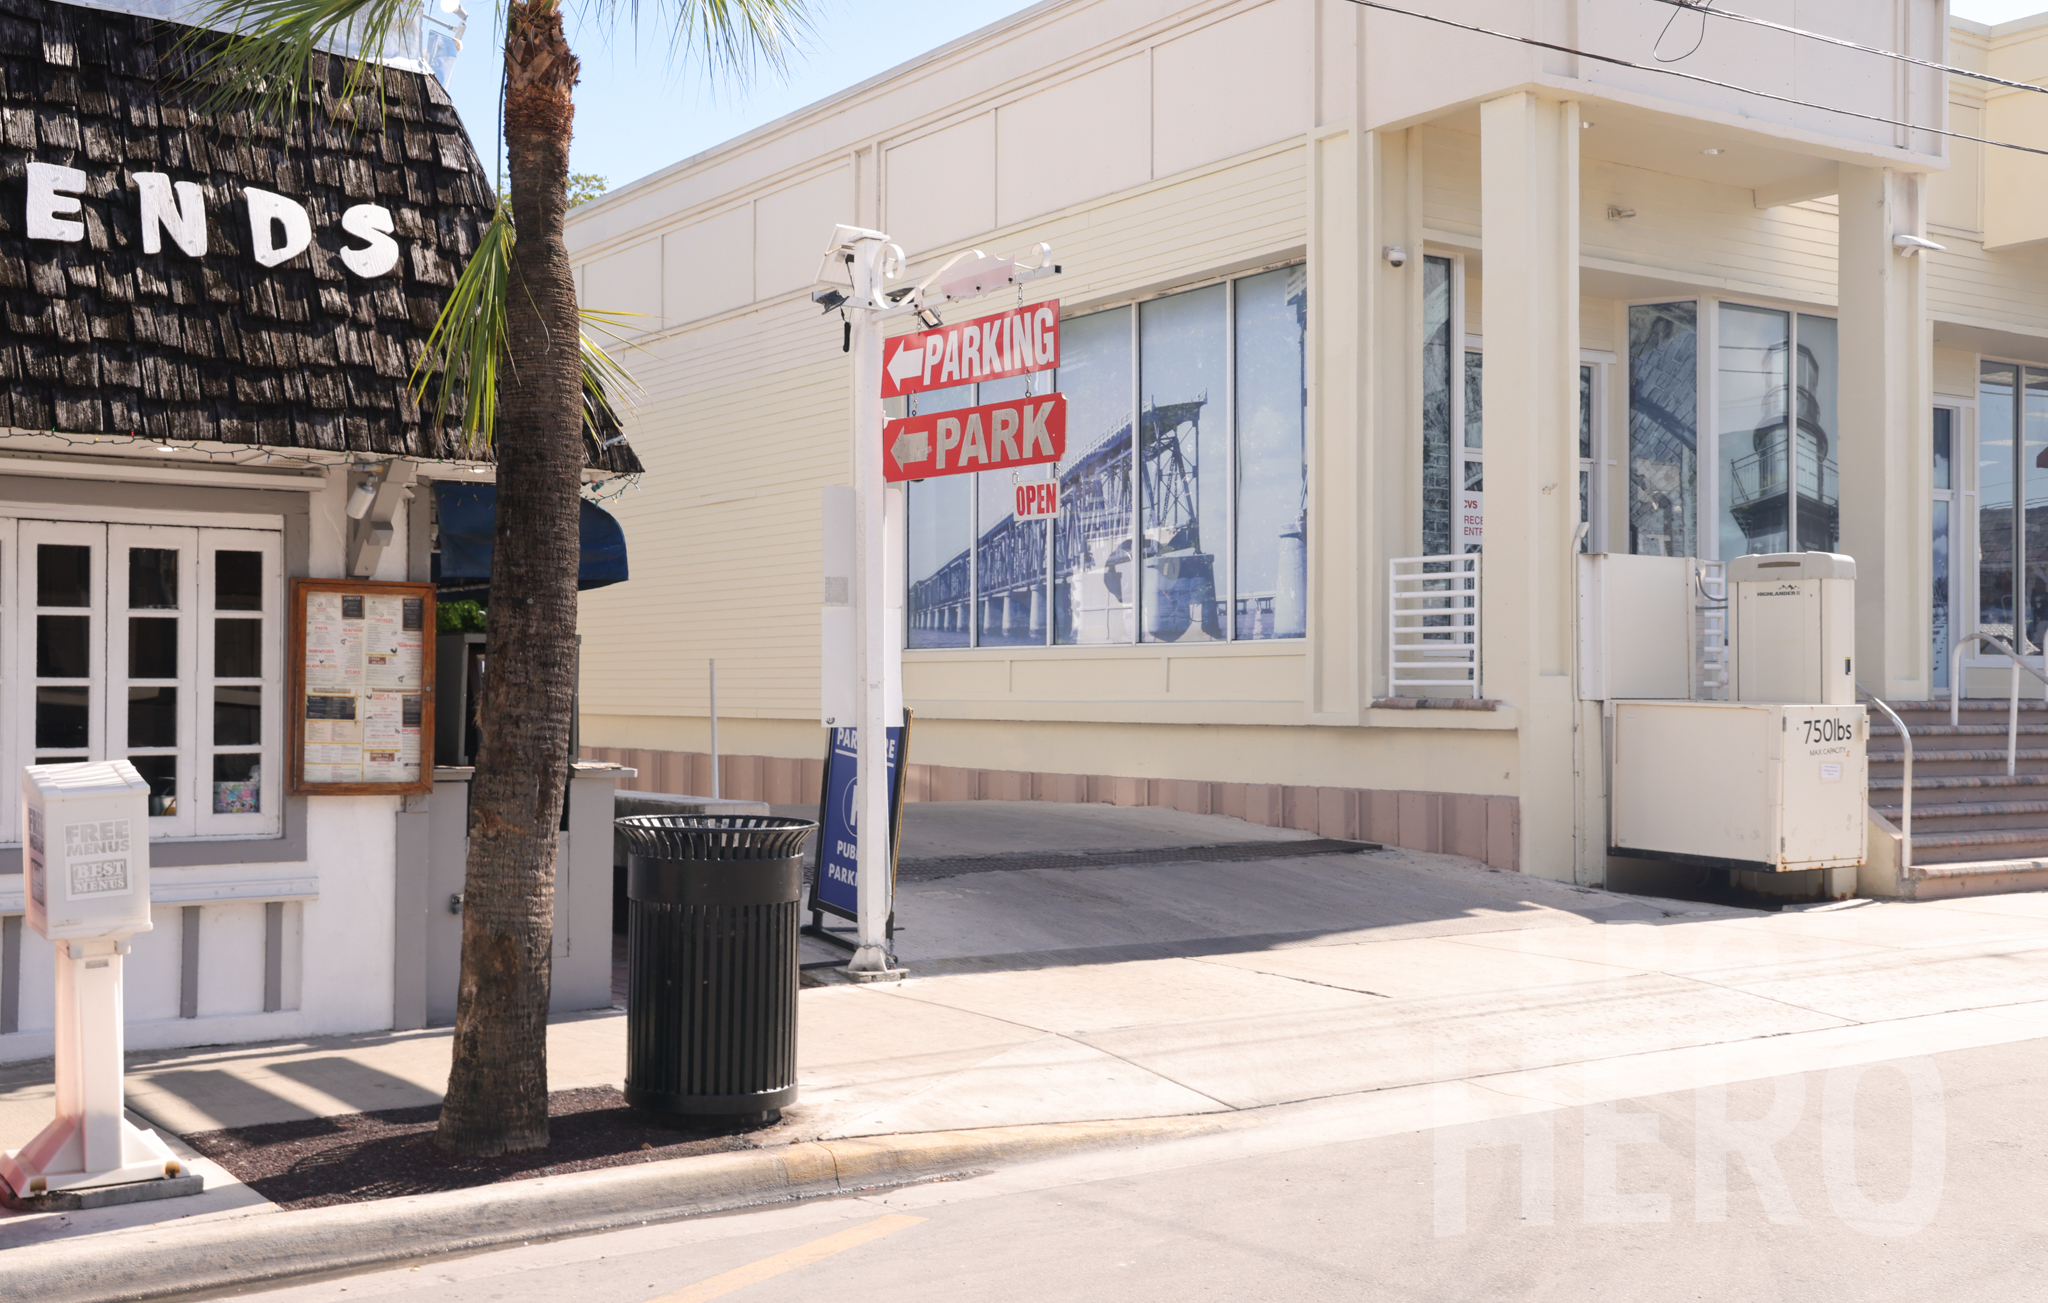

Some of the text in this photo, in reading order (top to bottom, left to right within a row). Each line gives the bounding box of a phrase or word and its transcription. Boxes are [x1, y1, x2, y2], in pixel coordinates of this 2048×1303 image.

[26, 162, 399, 278] ENDS
[923, 307, 1054, 386] PARKING
[936, 400, 1055, 470] PARK
[1016, 483, 1057, 516] OPEN
[837, 727, 858, 749] PAR
[1803, 718, 1852, 744] 750lbs
[1823, 746, 1846, 755] CAPACITY
[65, 820, 129, 844] FREE
[66, 840, 130, 857] MENUS
[836, 840, 858, 861] PUB
[73, 861, 124, 878] BEST
[74, 879, 124, 893] MENUS
